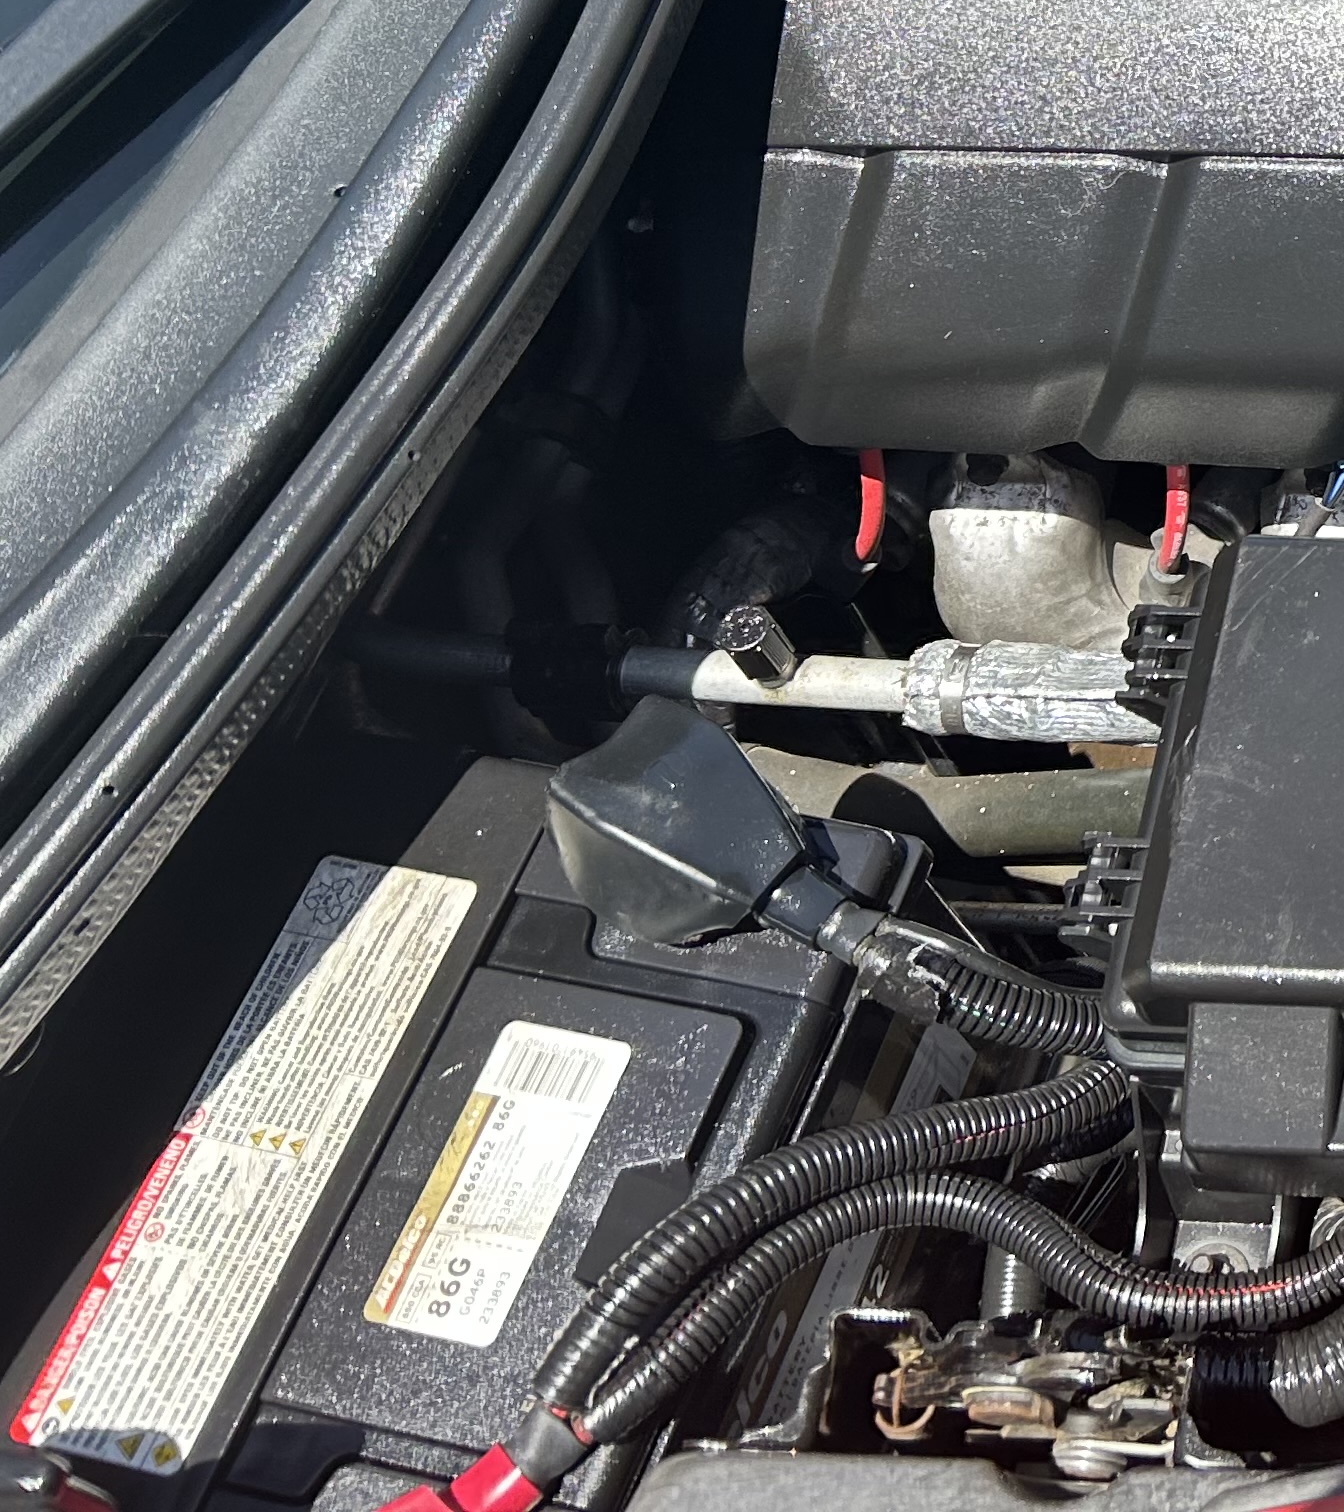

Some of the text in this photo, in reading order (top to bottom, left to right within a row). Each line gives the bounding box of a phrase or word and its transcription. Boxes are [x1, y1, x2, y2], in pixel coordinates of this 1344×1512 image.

[444, 1139, 497, 1225] 88866262
[490, 1098, 516, 1130] 86G
[108, 1137, 189, 1260] PELIGRO/VENENO
[489, 1181, 523, 1233] 233893
[424, 1254, 474, 1318] 86G
[457, 1267, 490, 1316] G046P
[477, 1270, 512, 1324] 233893
